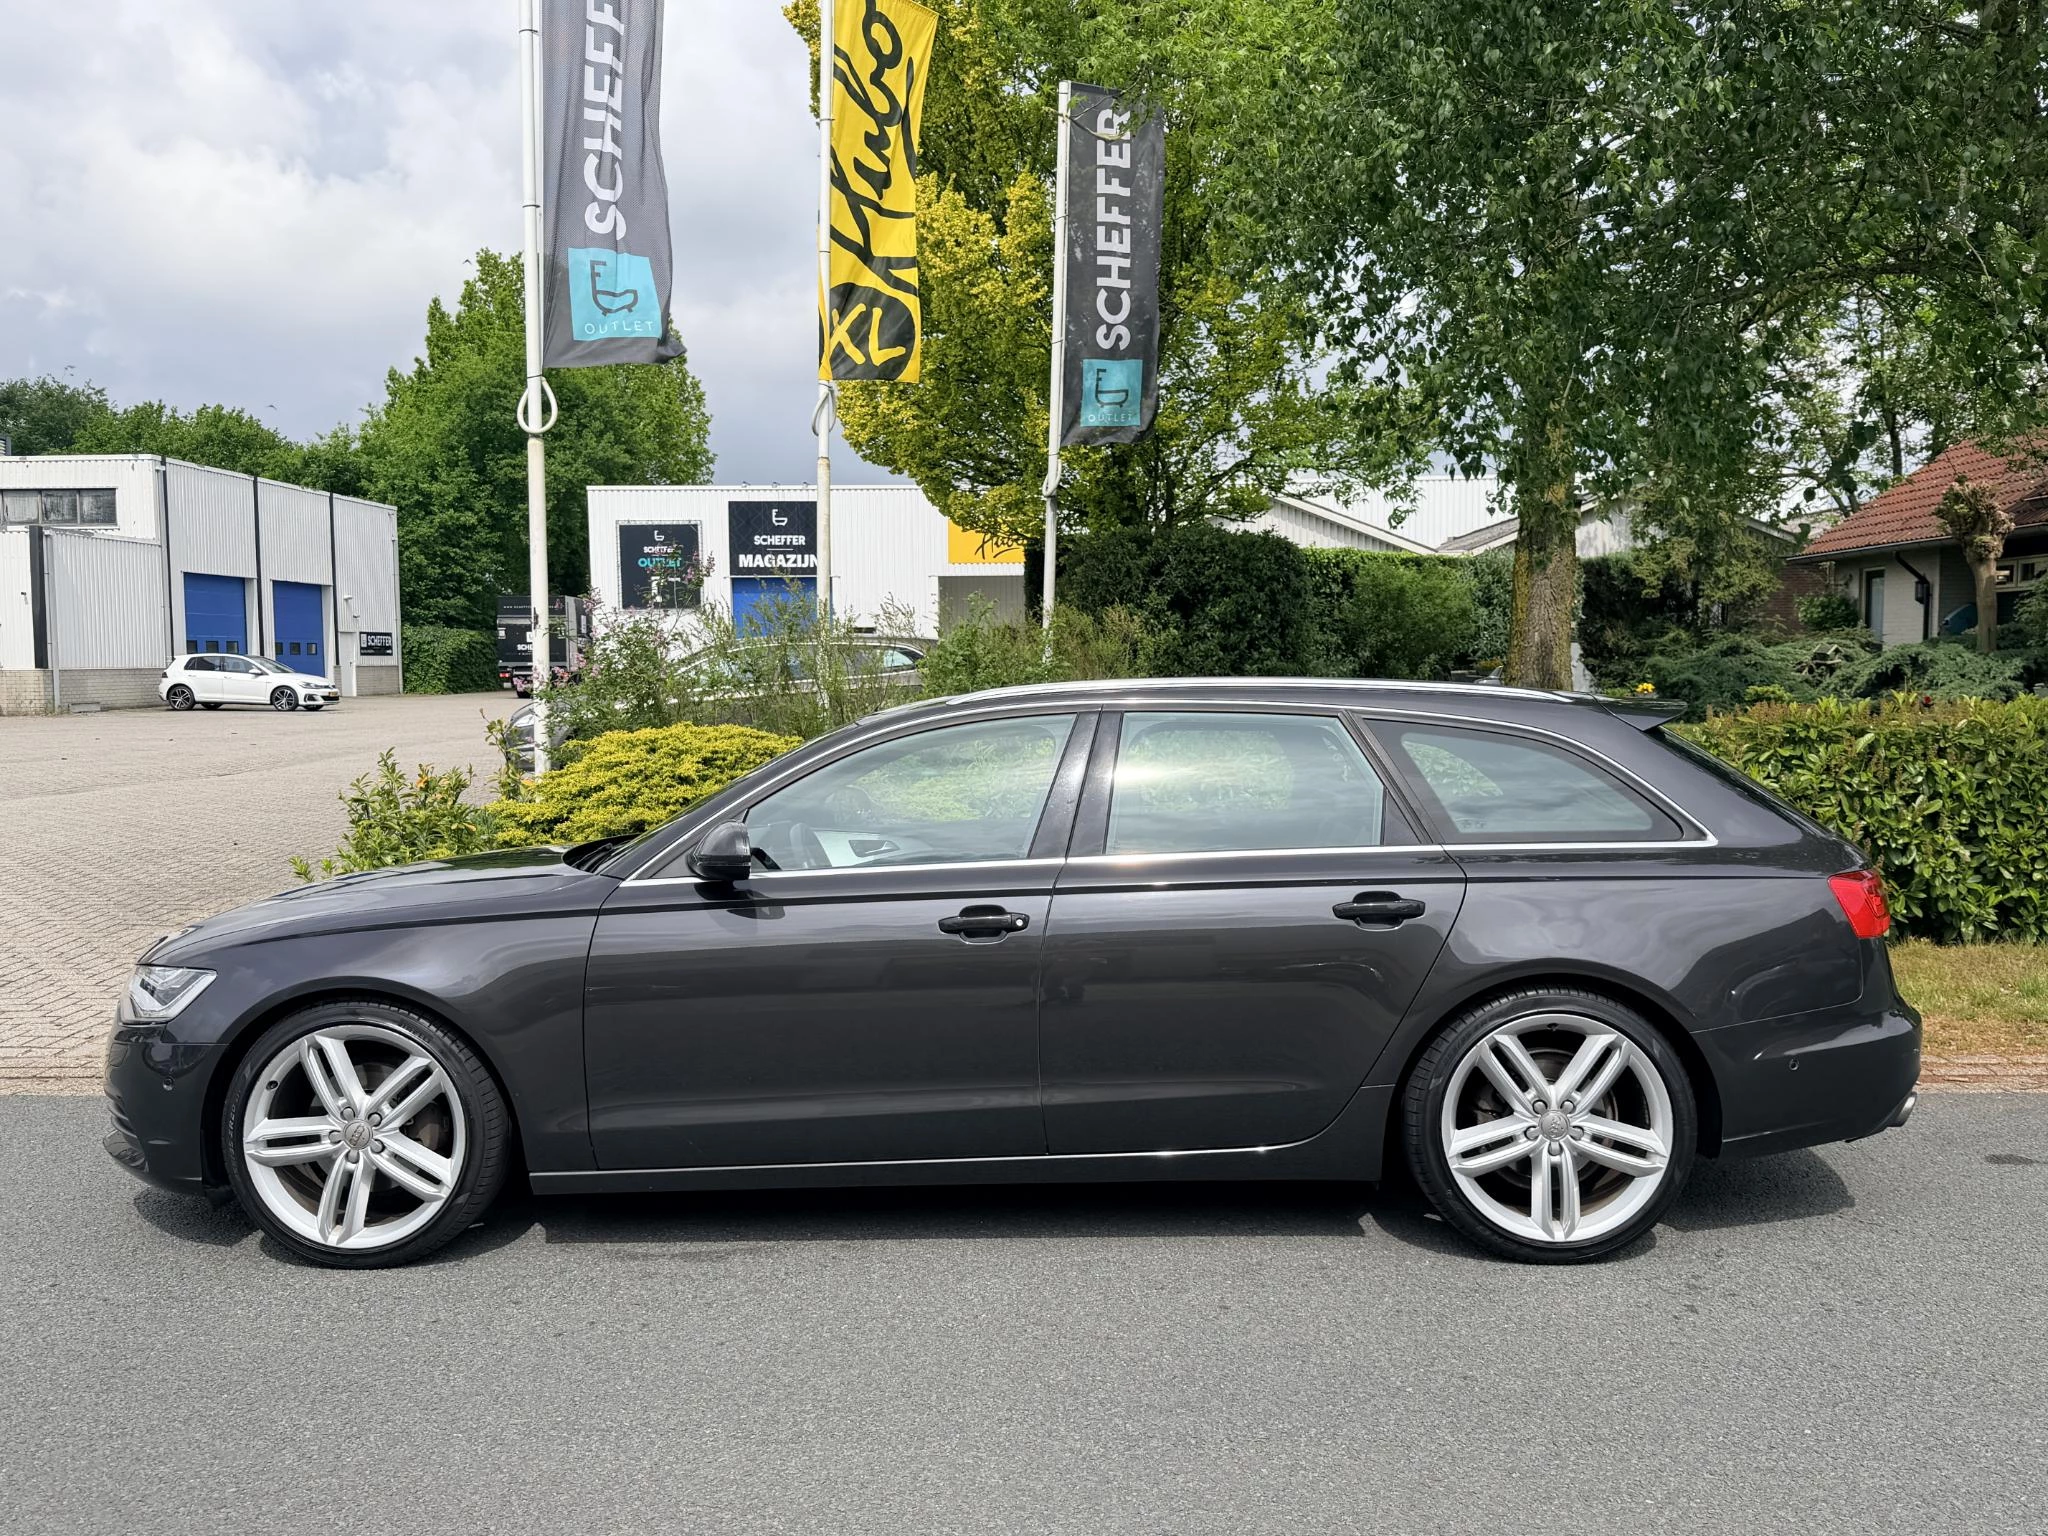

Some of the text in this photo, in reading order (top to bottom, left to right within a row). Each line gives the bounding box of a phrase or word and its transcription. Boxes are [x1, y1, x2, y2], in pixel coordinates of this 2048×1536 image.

[1096, 108, 1131, 351] SCHEFFER
[584, 320, 654, 335] OUTLET
[829, 302, 907, 367] XL
[1087, 413, 1133, 423] OUTLET
[753, 534, 806, 546] SCHEFFER
[367, 635, 392, 647] SCHEFFER
